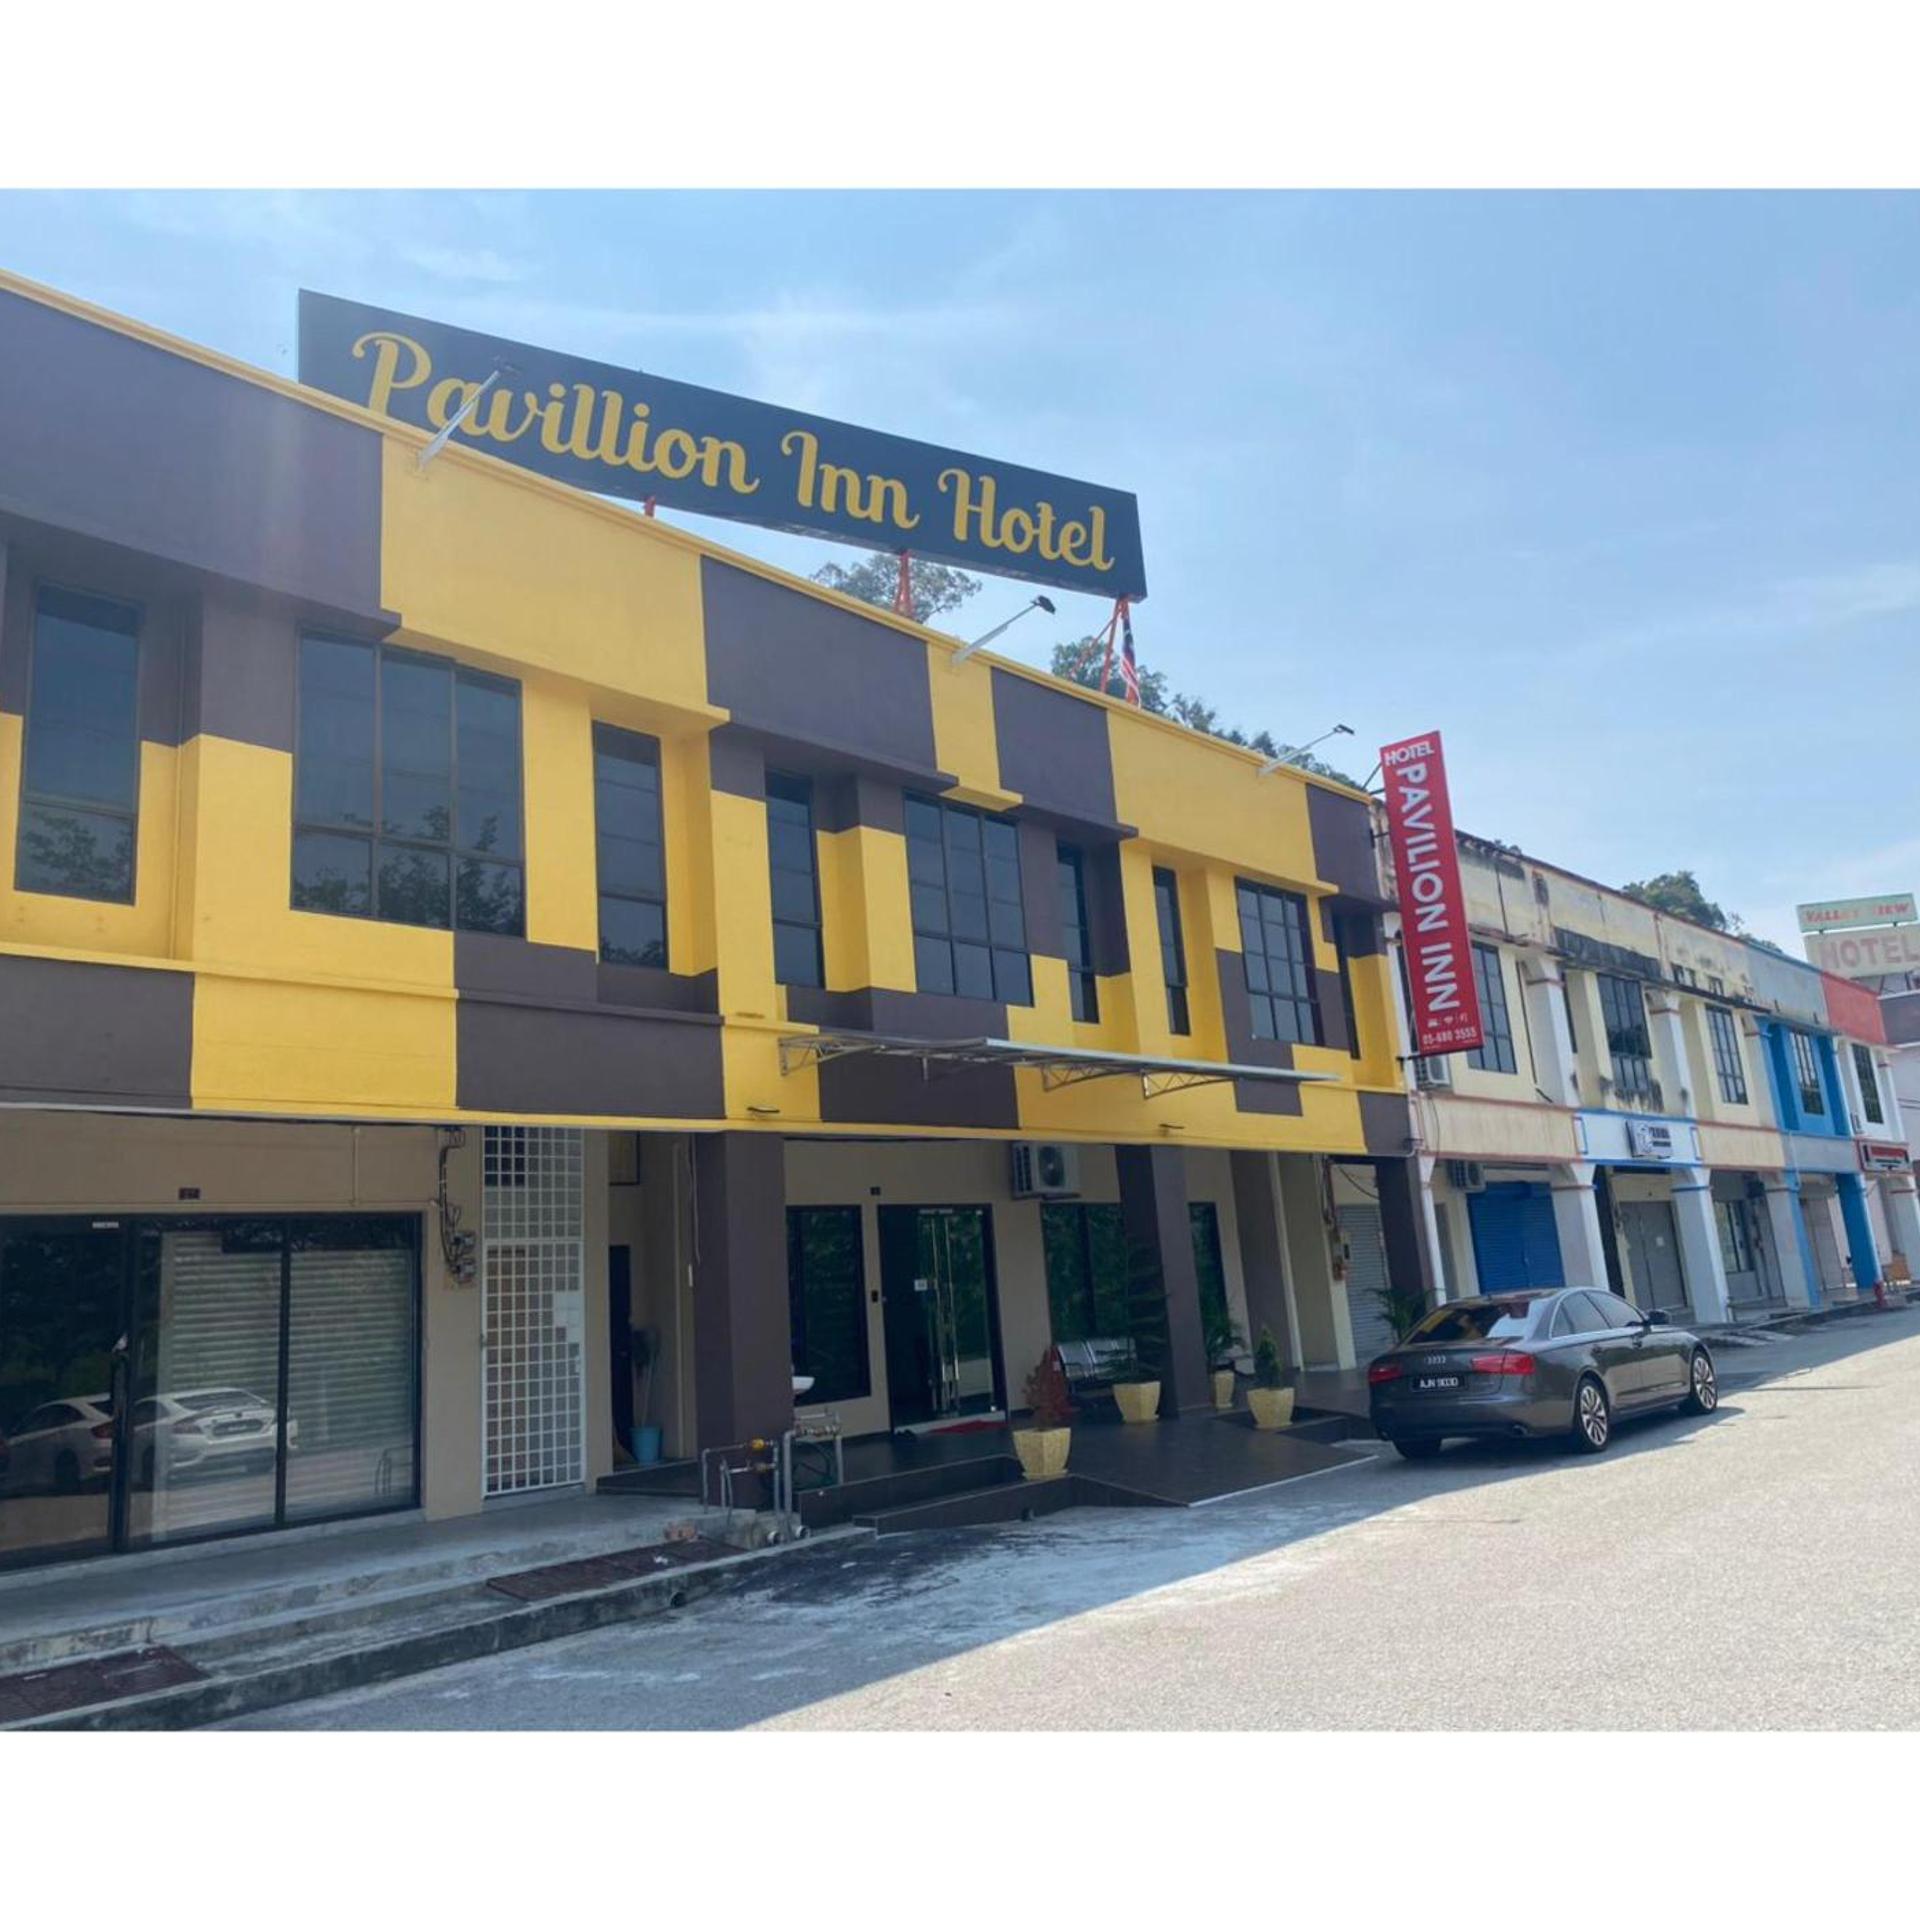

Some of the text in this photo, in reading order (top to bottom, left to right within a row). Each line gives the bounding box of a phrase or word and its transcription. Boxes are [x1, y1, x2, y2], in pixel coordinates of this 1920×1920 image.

[353, 332, 1115, 571] Pavillion Inn Hotel
[1384, 740, 1435, 766] HOTEL
[1396, 762, 1449, 932] PAVILION
[1871, 902, 1910, 917] IEW
[1421, 943, 1461, 1012] INN
[1819, 934, 1920, 969] HOTEL
